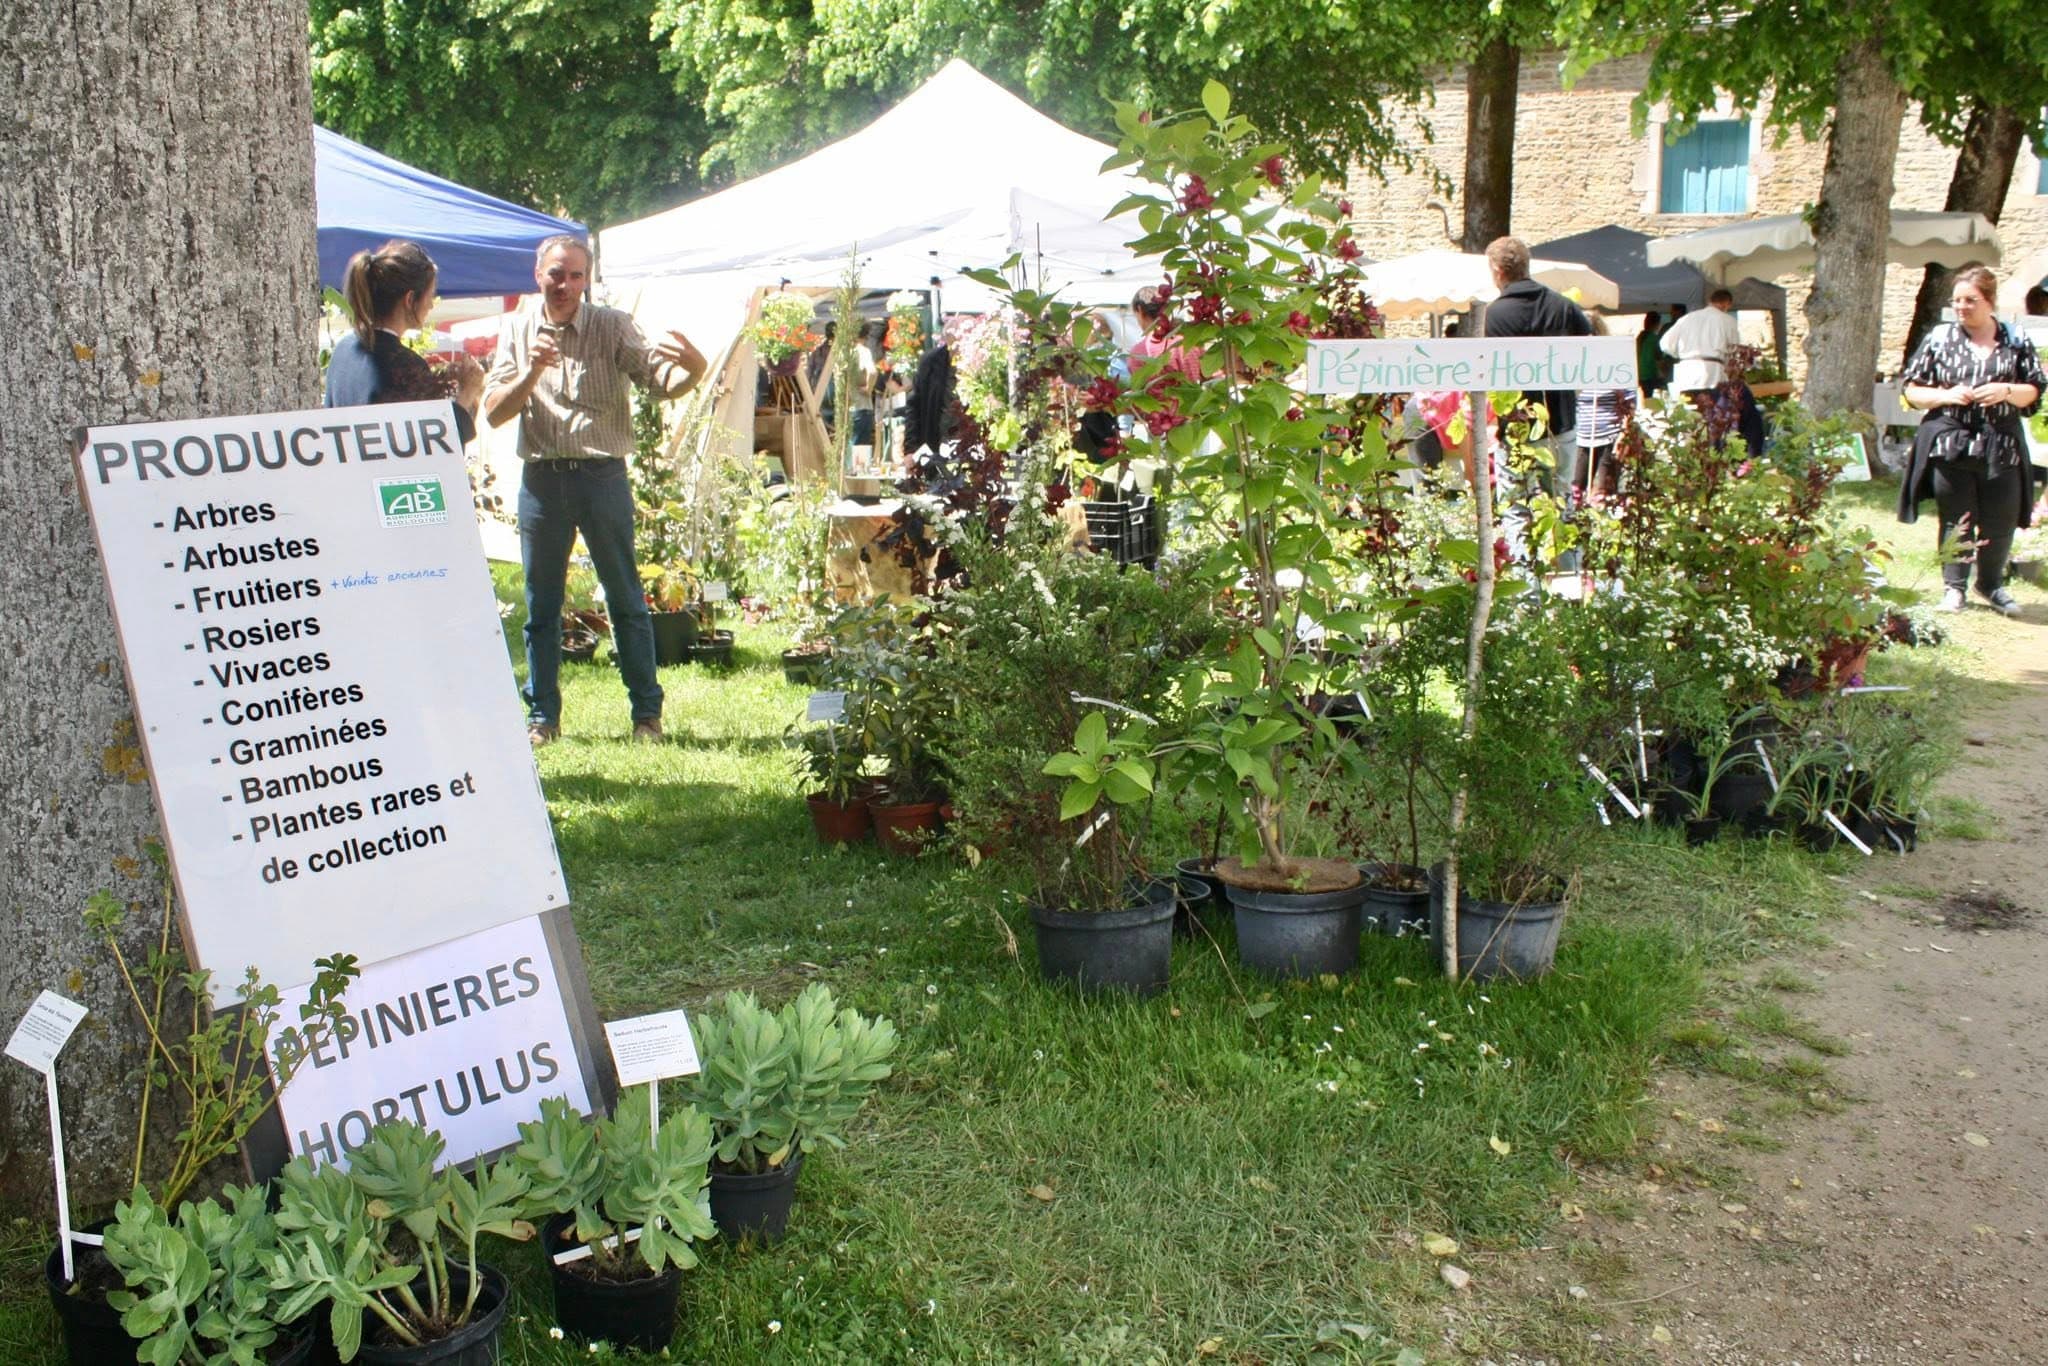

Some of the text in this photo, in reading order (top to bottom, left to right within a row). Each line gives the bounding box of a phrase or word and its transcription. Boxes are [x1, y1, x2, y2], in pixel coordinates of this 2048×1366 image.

[1316, 344, 1635, 393] Pépinière Hortulus
[93, 418, 454, 485] PRODUCTEUR
[173, 502, 276, 533] Arbres
[388, 491, 436, 514] AB
[183, 536, 320, 573] Arbustes
[192, 578, 322, 614] Fruitiers
[202, 616, 321, 654] Rosiers
[209, 652, 331, 689] Vivaces
[221, 683, 364, 726] Conifères
[229, 717, 388, 766] Graminées
[240, 758, 384, 805] Bambous
[250, 800, 363, 843] Plantes
[370, 783, 442, 816] rares
[449, 771, 476, 797] et
[261, 824, 447, 884] de collection
[299, 1042, 559, 1172] HORTULUS
